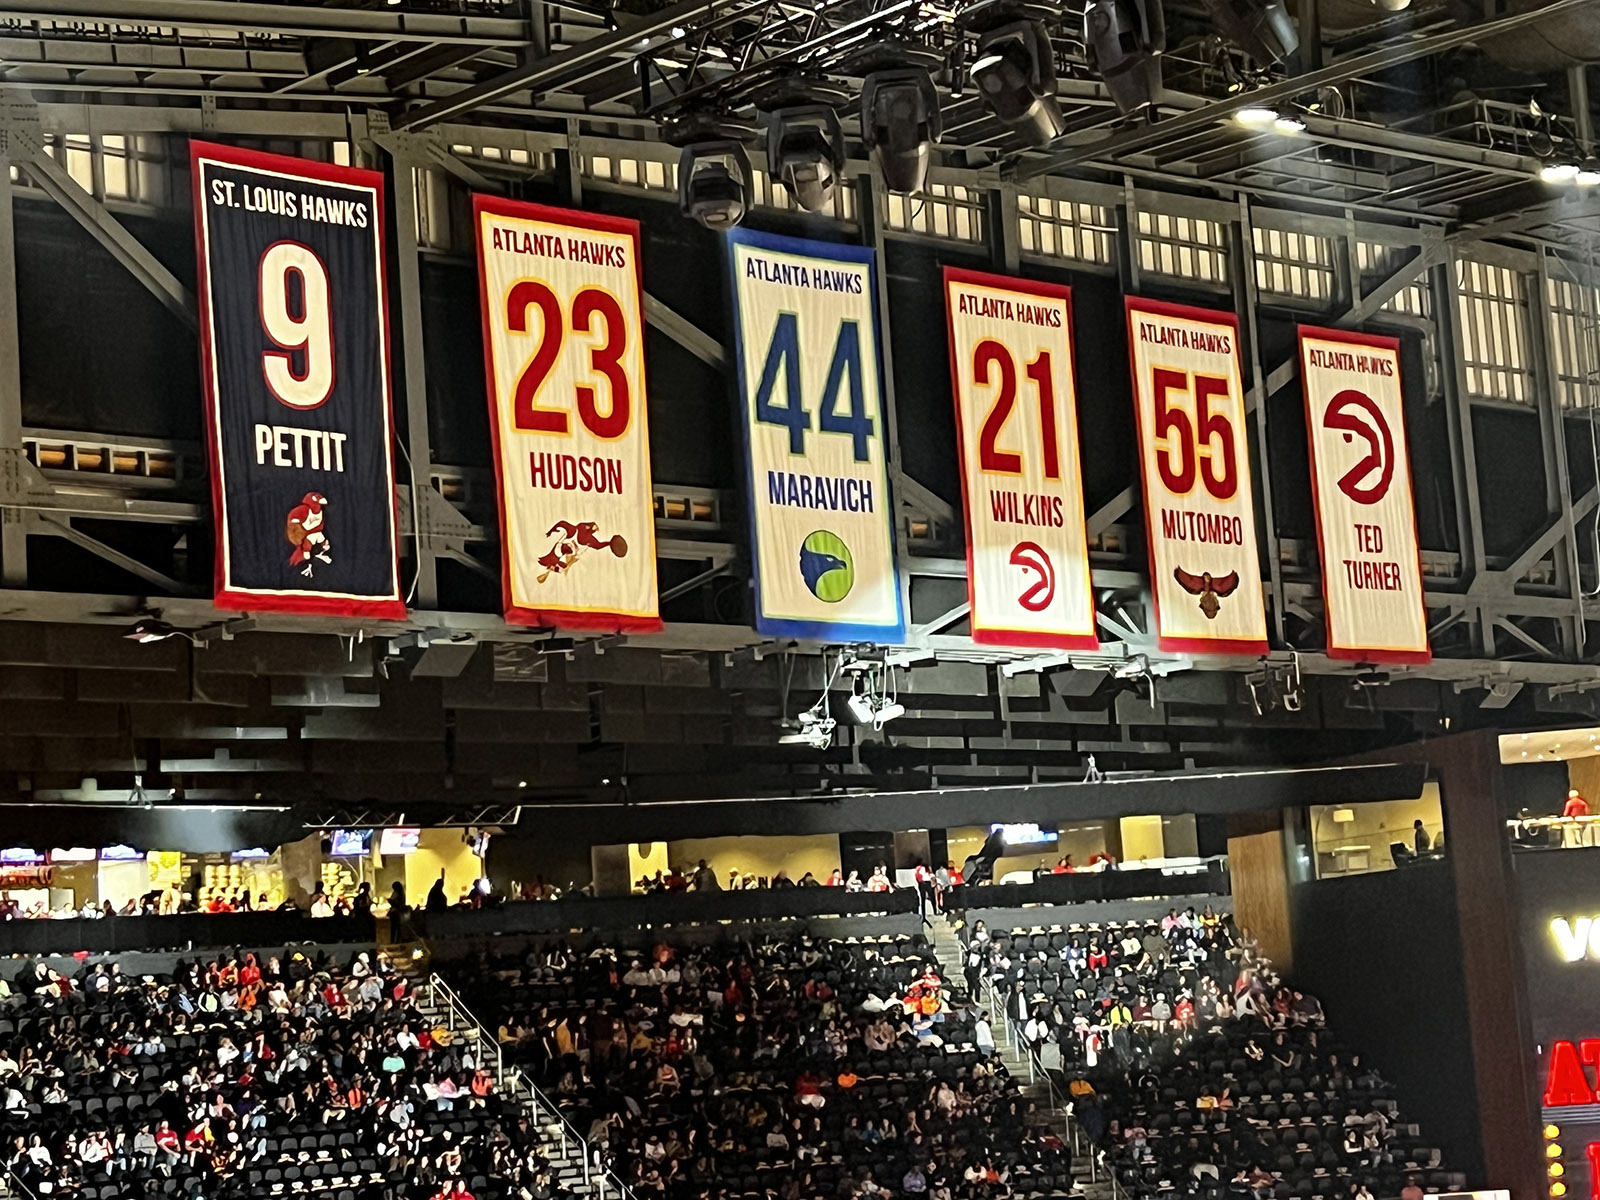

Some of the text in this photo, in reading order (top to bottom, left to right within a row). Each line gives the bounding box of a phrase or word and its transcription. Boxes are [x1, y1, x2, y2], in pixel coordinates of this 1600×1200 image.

[211, 179, 368, 228] ST. LOUIS HAWKS
[493, 227, 626, 269] ATLANTA HAWKS
[746, 257, 862, 295] ATLANTA HAWKS
[259, 241, 335, 409] 9
[959, 293, 1061, 328] ATLANTA HAWKS
[506, 280, 630, 439] 23
[1140, 322, 1231, 354] ATLANTA HAWKS
[1309, 348, 1393, 377] ATLANTA HAWKS
[755, 311, 875, 462] 44
[973, 340, 1060, 479] 21
[254, 423, 347, 473] PETTIT
[1152, 367, 1238, 500] 55
[529, 451, 623, 495] HUDSON
[767, 470, 874, 513] MARAVICH
[989, 489, 1064, 528] WILKINS
[1161, 508, 1243, 546] MUTOMBO
[1353, 523, 1384, 554] TED
[1342, 559, 1402, 591] TURNER
[1549, 915, 1600, 962] V
